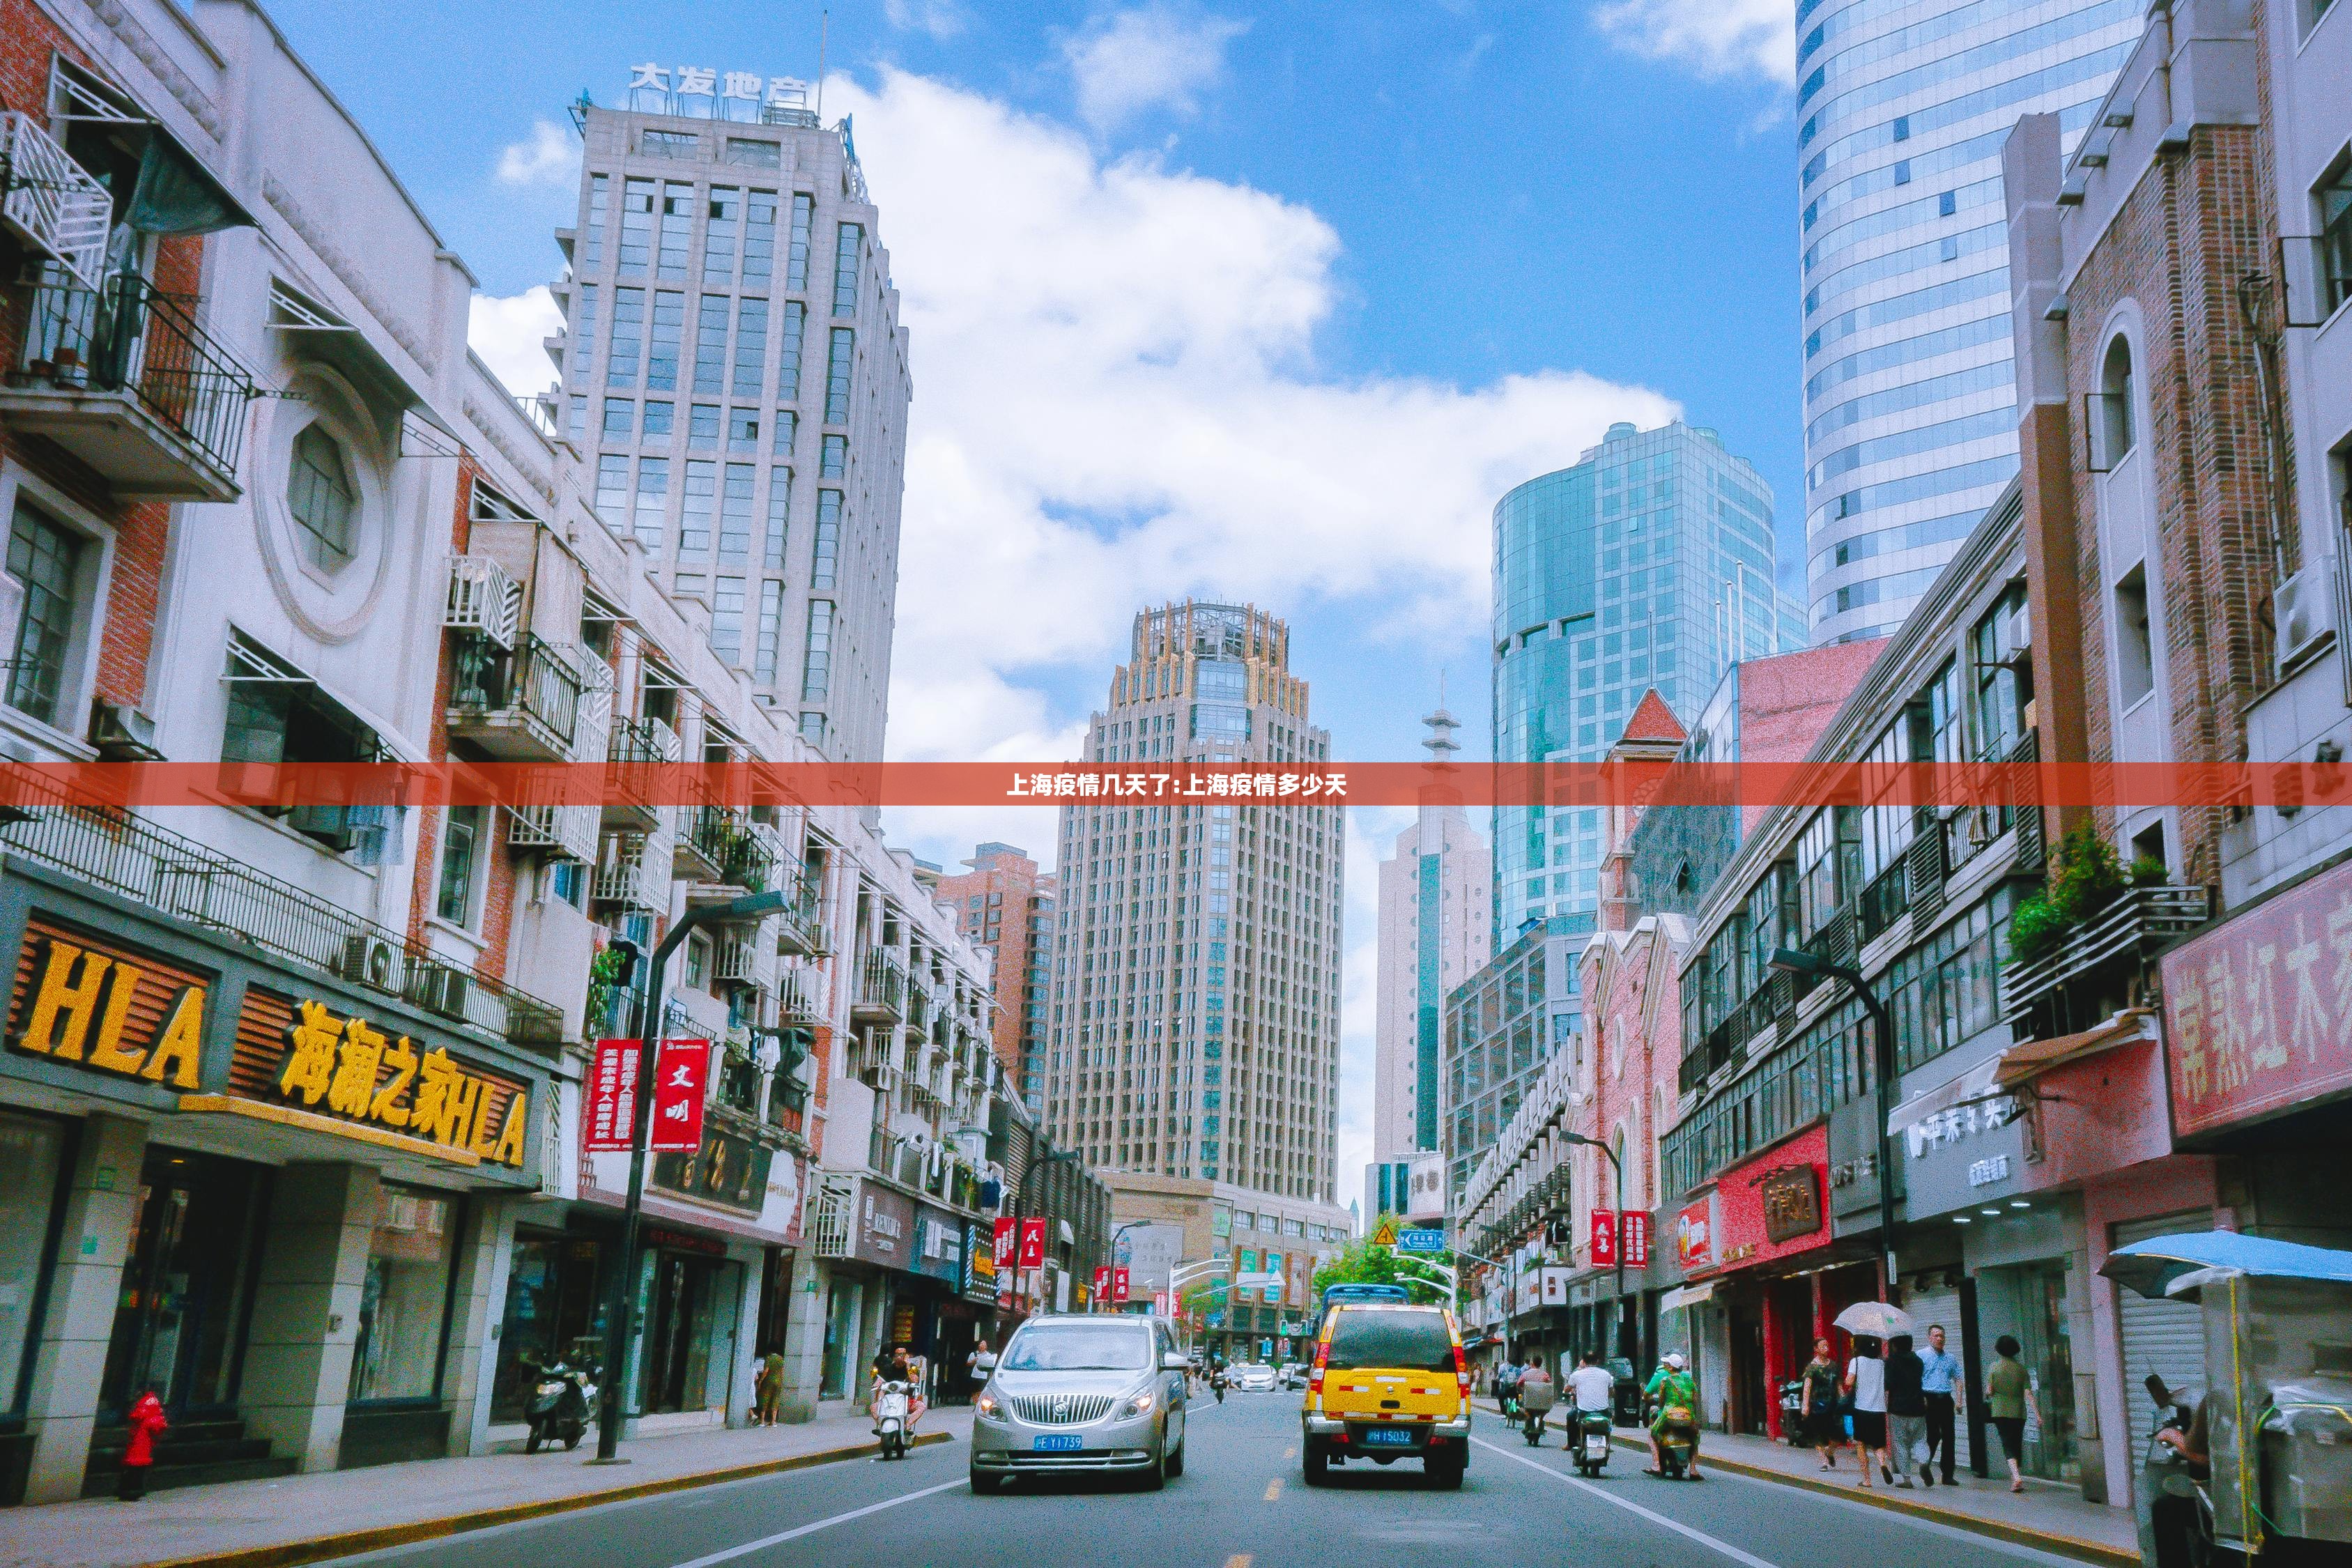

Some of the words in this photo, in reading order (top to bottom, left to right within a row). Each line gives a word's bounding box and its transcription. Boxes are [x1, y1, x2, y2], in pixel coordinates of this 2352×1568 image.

[629, 62, 808, 102] 大发地产
[20, 939, 206, 1089] HLA
[433, 1070, 527, 1167] HLA
[664, 1064, 695, 1123] 文明
